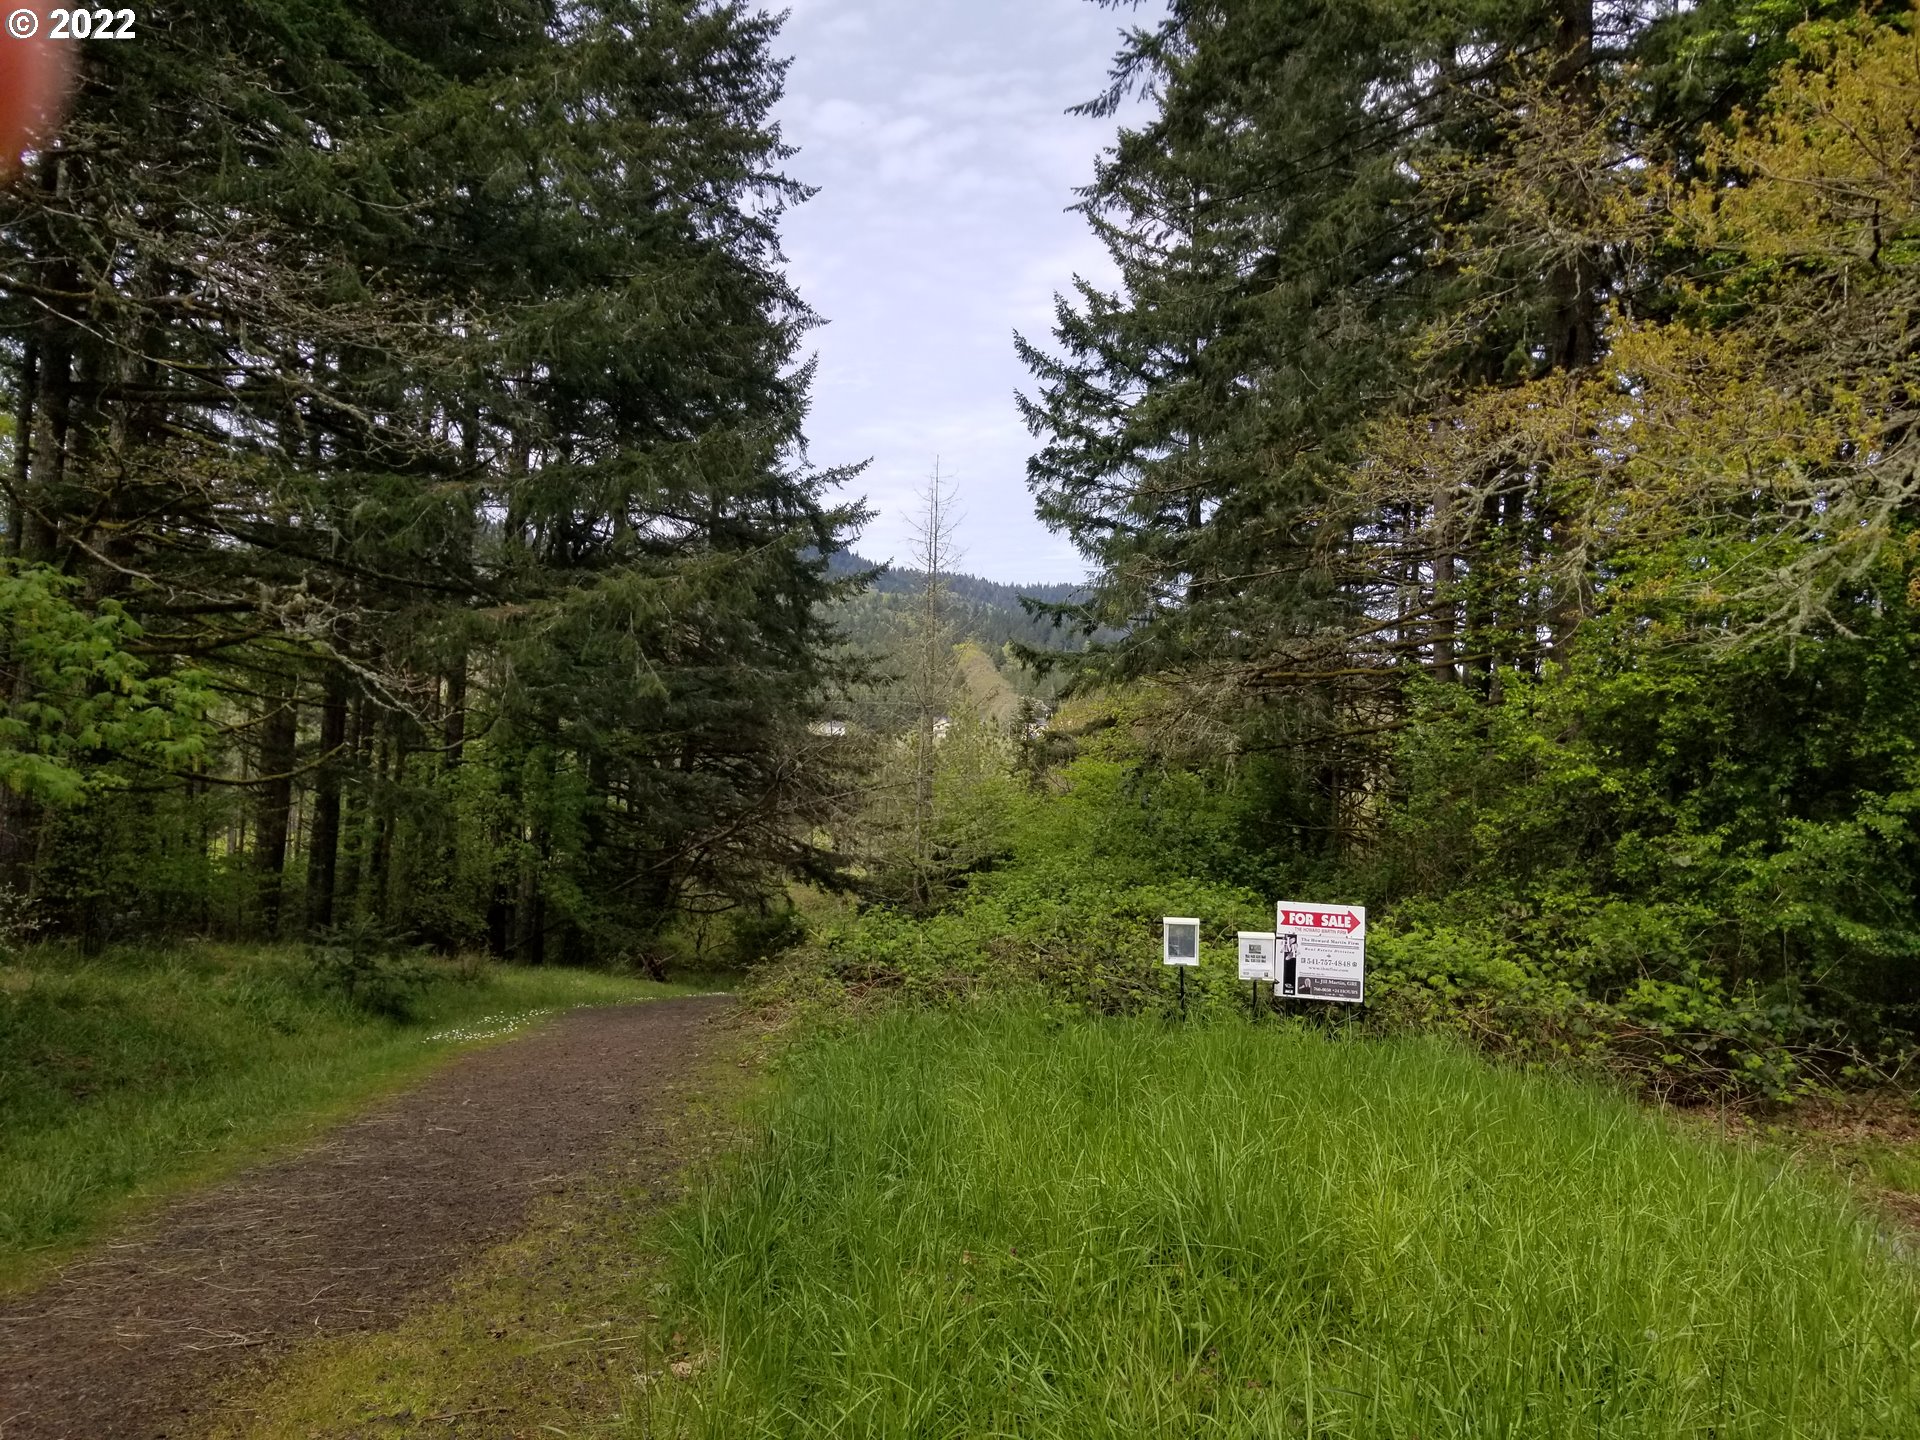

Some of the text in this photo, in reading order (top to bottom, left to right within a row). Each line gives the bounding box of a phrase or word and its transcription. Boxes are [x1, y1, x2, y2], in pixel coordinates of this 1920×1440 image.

[1289, 912, 1351, 928] FOR SALE
[1306, 957, 1351, 967] 541-757-4848
